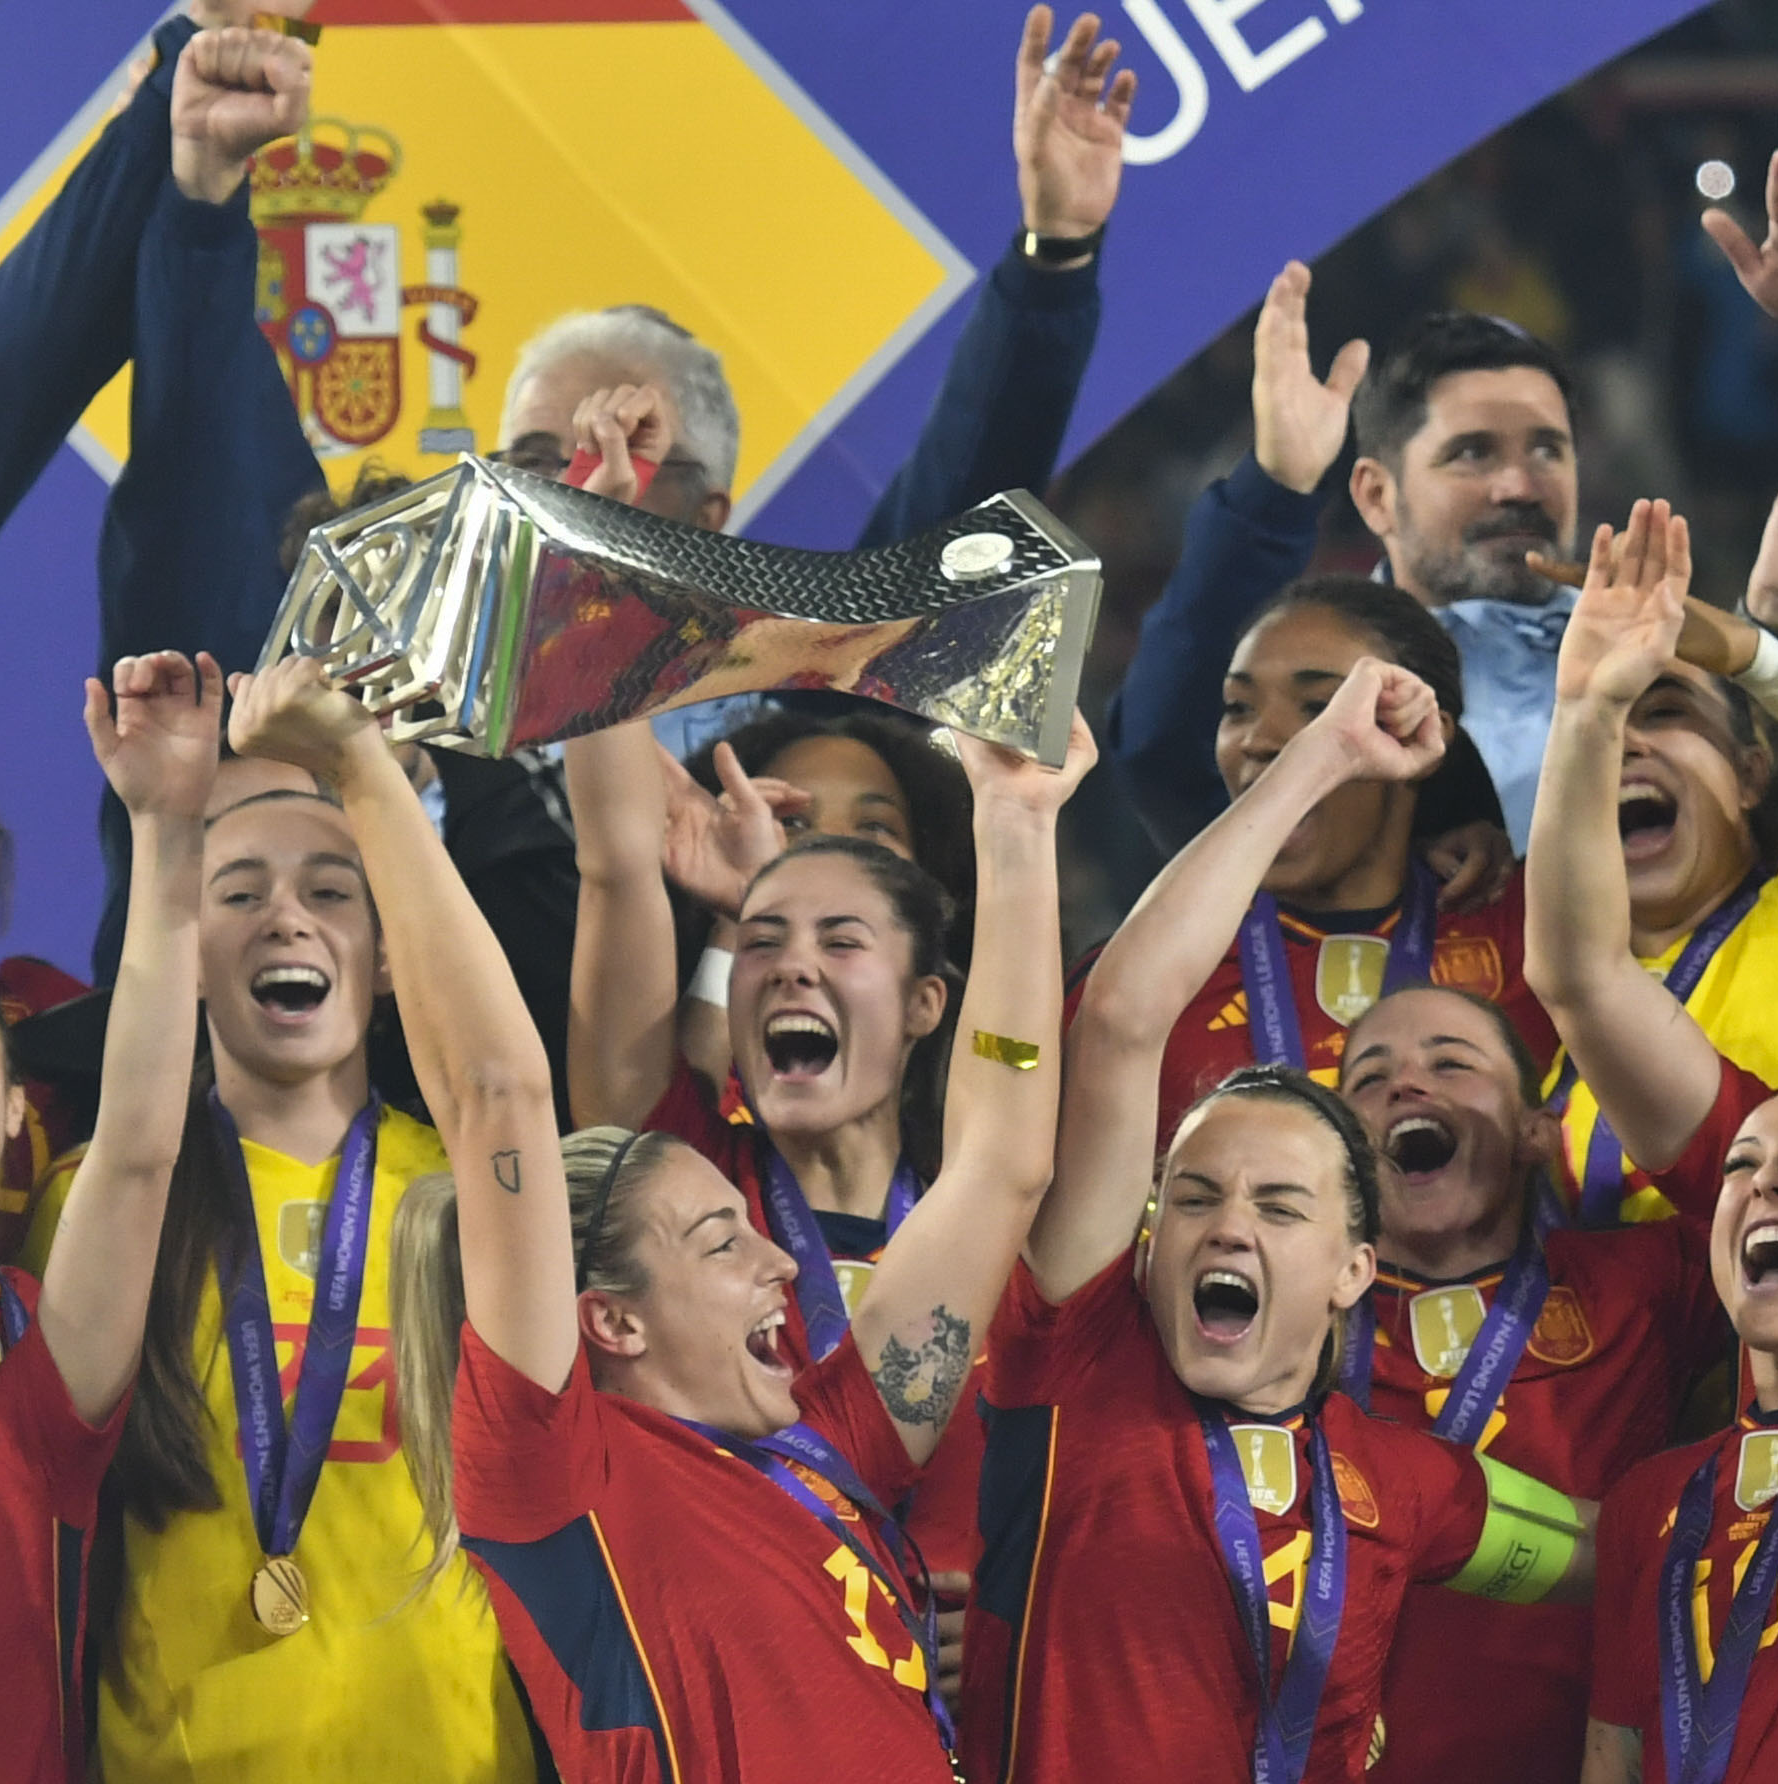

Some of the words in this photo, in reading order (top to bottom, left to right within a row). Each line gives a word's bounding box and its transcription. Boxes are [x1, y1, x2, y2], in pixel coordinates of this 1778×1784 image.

[1122, 0, 1364, 165] UE
[773, 1189, 808, 1252] LEAGUE
[329, 1272, 347, 1312] UEFA
[240, 1319, 261, 1362] UEFA
[1471, 1322, 1515, 1393] NATIONS
[773, 1428, 829, 1463] EAGUE
[1233, 1538, 1254, 1581] UEFA
[1317, 1558, 1335, 1600] UEFA
[1748, 1552, 1773, 1596] UEFA
